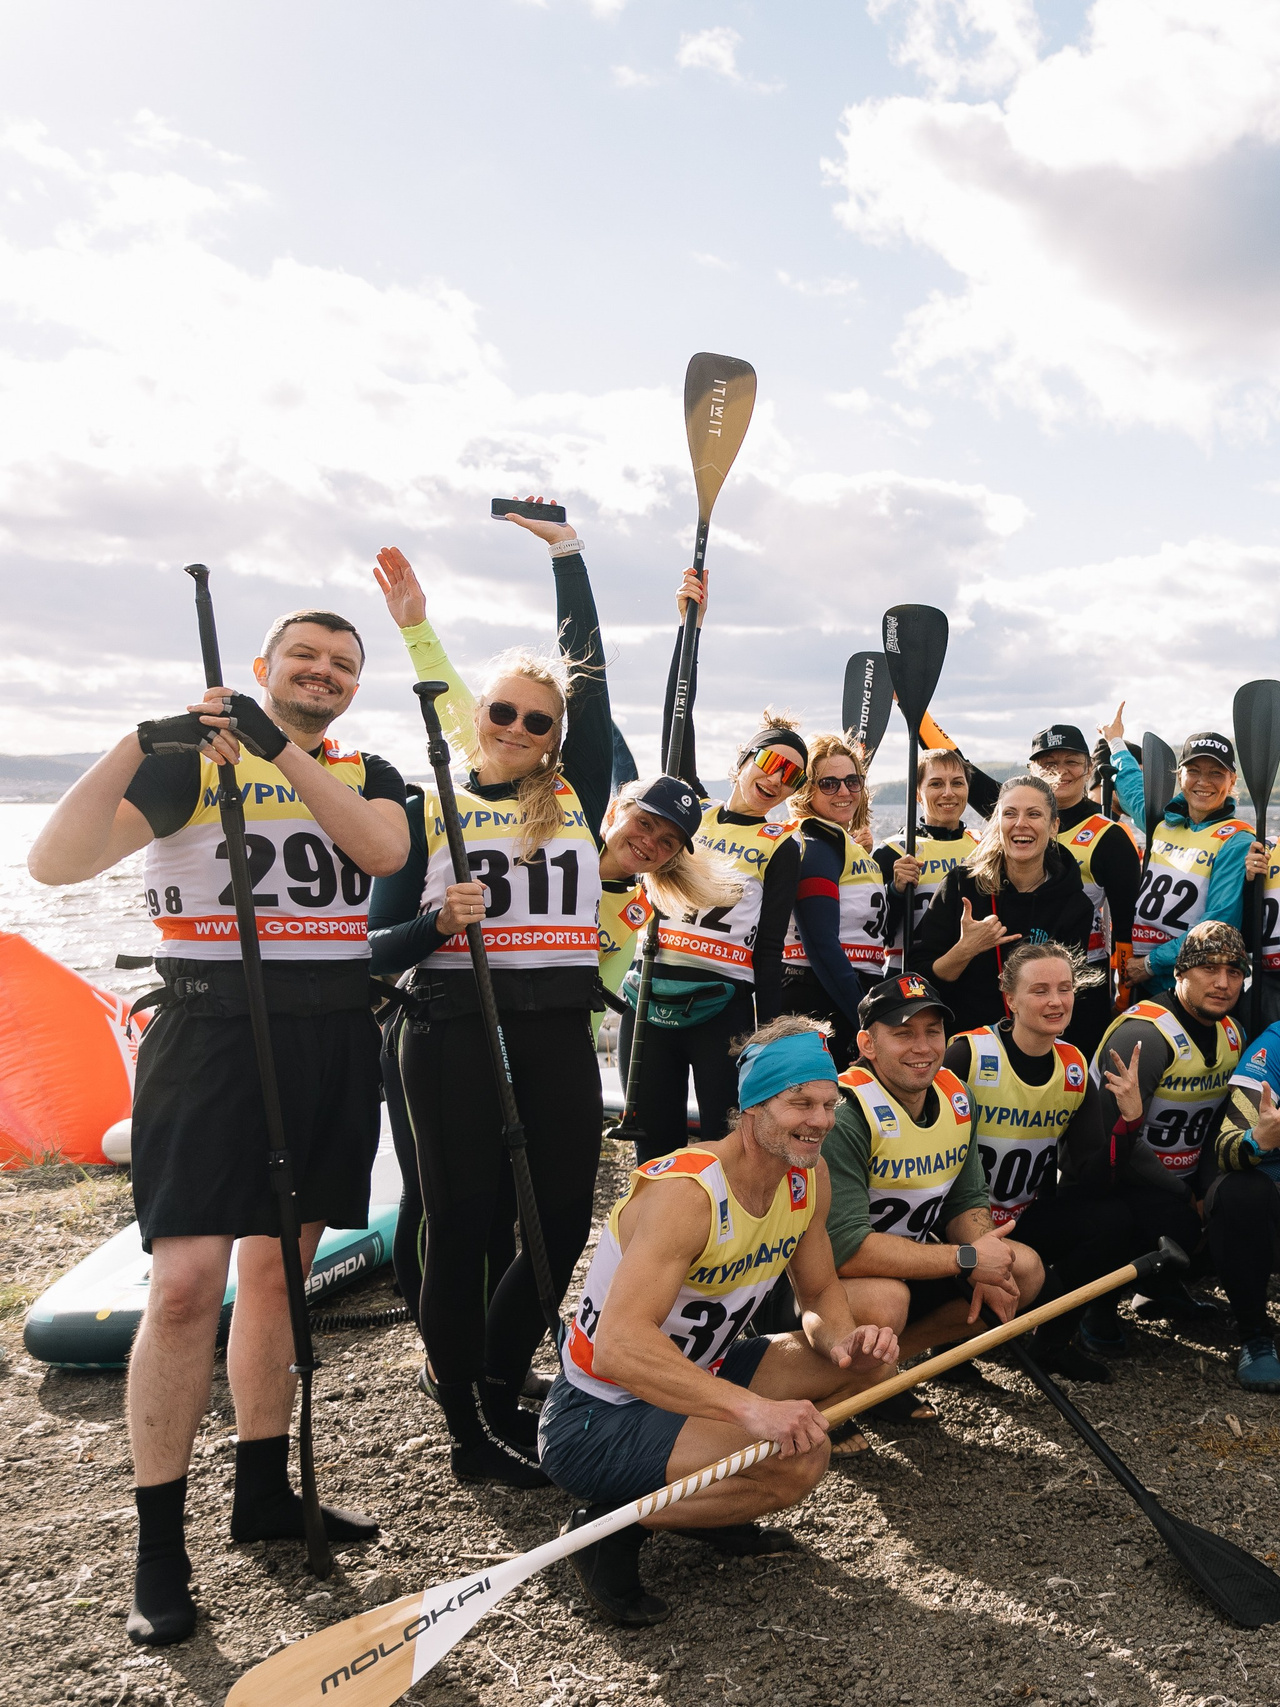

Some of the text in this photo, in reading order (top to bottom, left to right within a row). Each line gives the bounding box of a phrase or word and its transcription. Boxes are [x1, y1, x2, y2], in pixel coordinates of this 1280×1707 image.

[708, 379, 727, 437] ITIWIT
[675, 679, 687, 720] ITIWIT
[858, 659, 875, 740] KING PADDLE
[1190, 739, 1229, 753] VOLVO
[215, 832, 372, 907] 298
[467, 848, 578, 918] 311
[869, 1143, 969, 1180] МУРМАНС
[688, 1230, 806, 1285] МУРМАНС
[321, 1576, 492, 1695] MOLOKAI
